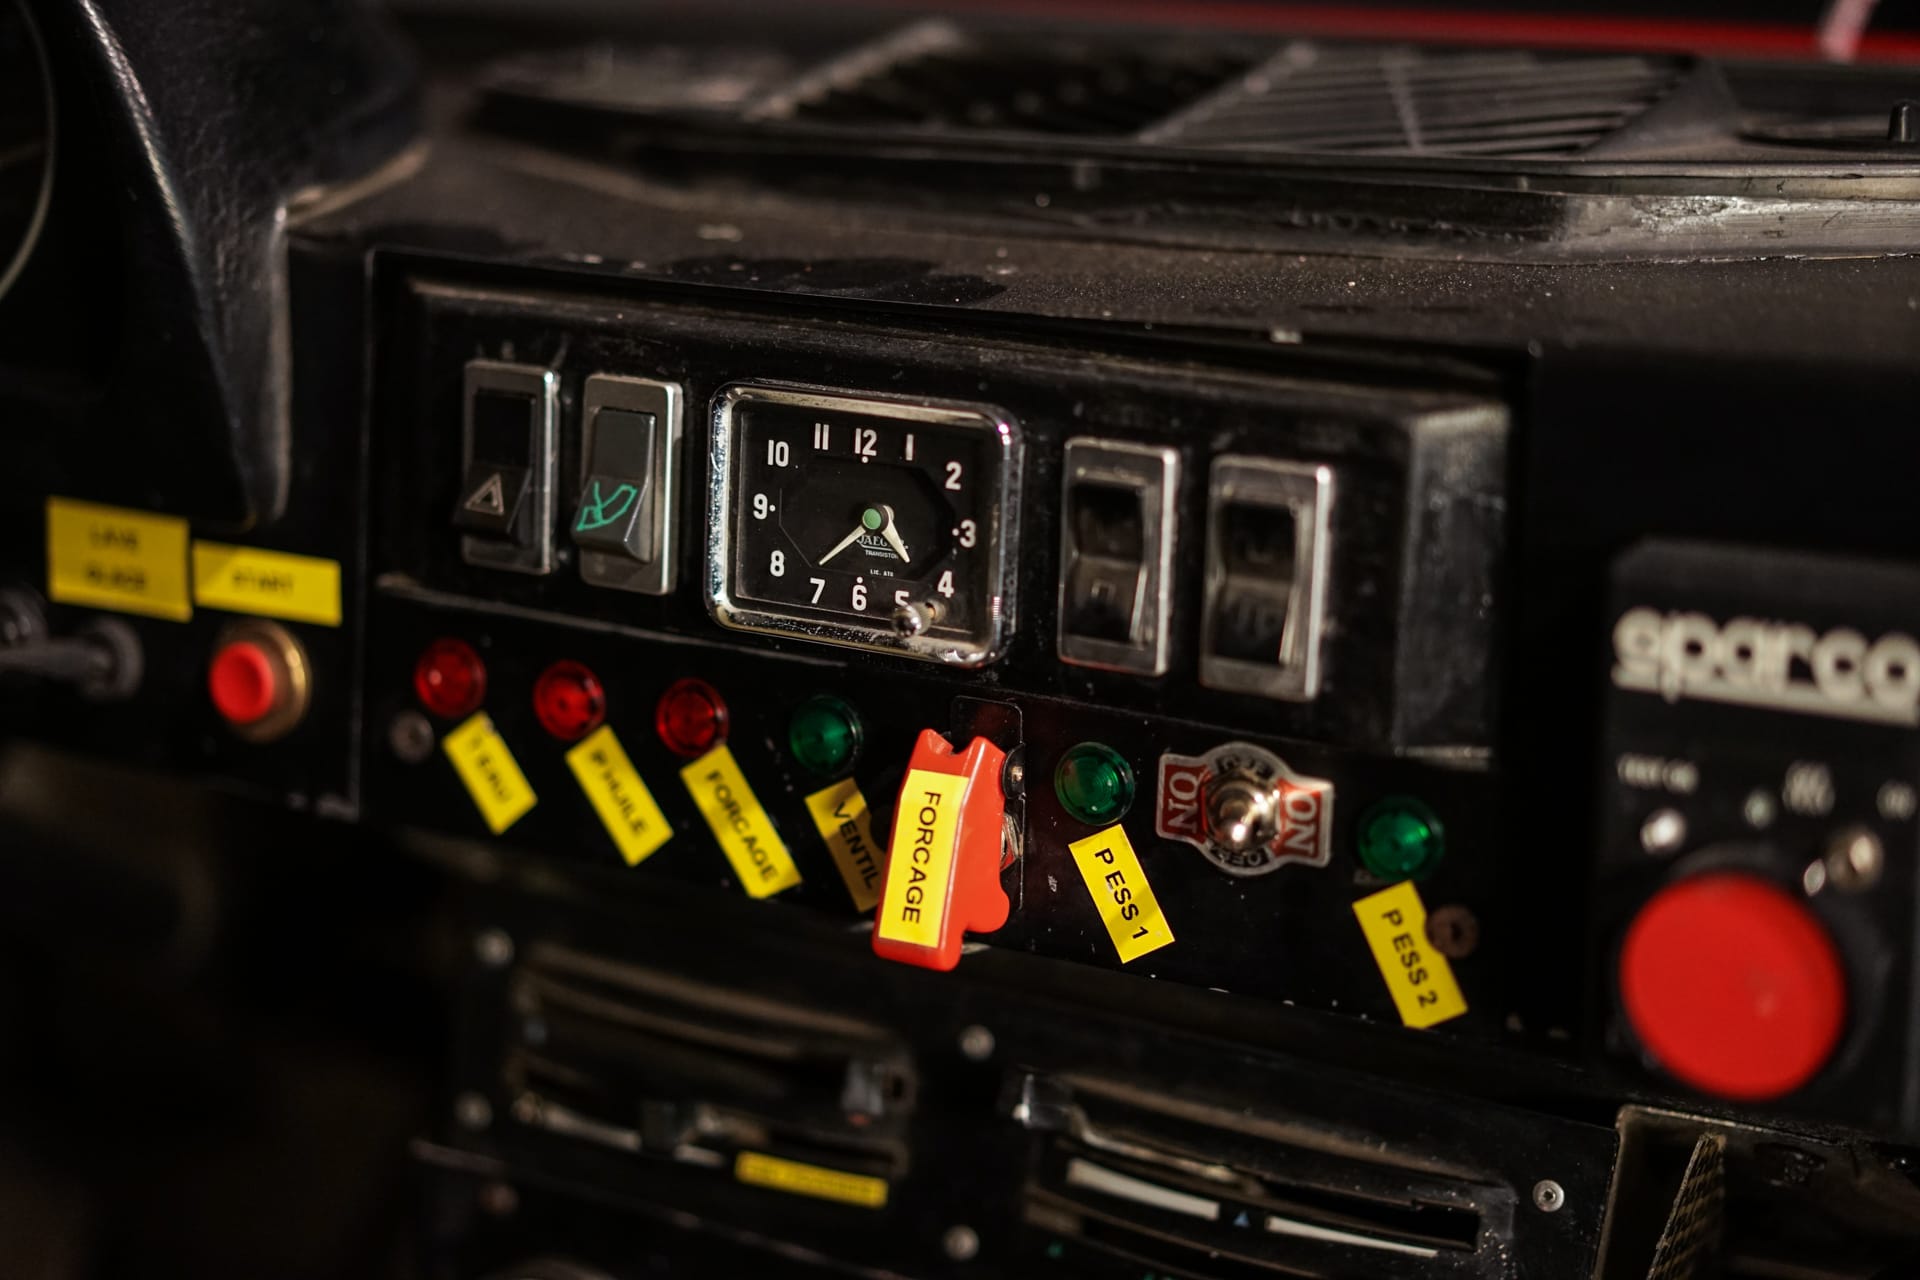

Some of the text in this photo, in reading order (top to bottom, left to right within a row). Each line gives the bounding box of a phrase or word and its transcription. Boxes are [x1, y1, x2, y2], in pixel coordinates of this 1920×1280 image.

[814, 423, 829, 450] 11
[854, 428, 877, 456] 12
[905, 434, 914, 461] 1
[767, 440, 789, 467] 10
[945, 462, 962, 490] 2
[753, 493, 768, 520] 9
[856, 534, 908, 550] JAEG
[959, 520, 976, 548] 3
[770, 550, 785, 577] 8
[809, 578, 825, 603] 7
[852, 584, 868, 611] 6
[937, 570, 954, 598] 4
[1167, 771, 1200, 834] ON
[705, 769, 779, 883] FORCAGE
[1284, 791, 1318, 855] ON
[832, 801, 883, 890] VENTIL
[901, 791, 942, 925] FORCAGE
[1094, 847, 1150, 941] P ESS 1
[1381, 908, 1438, 1009] P ESS 2
